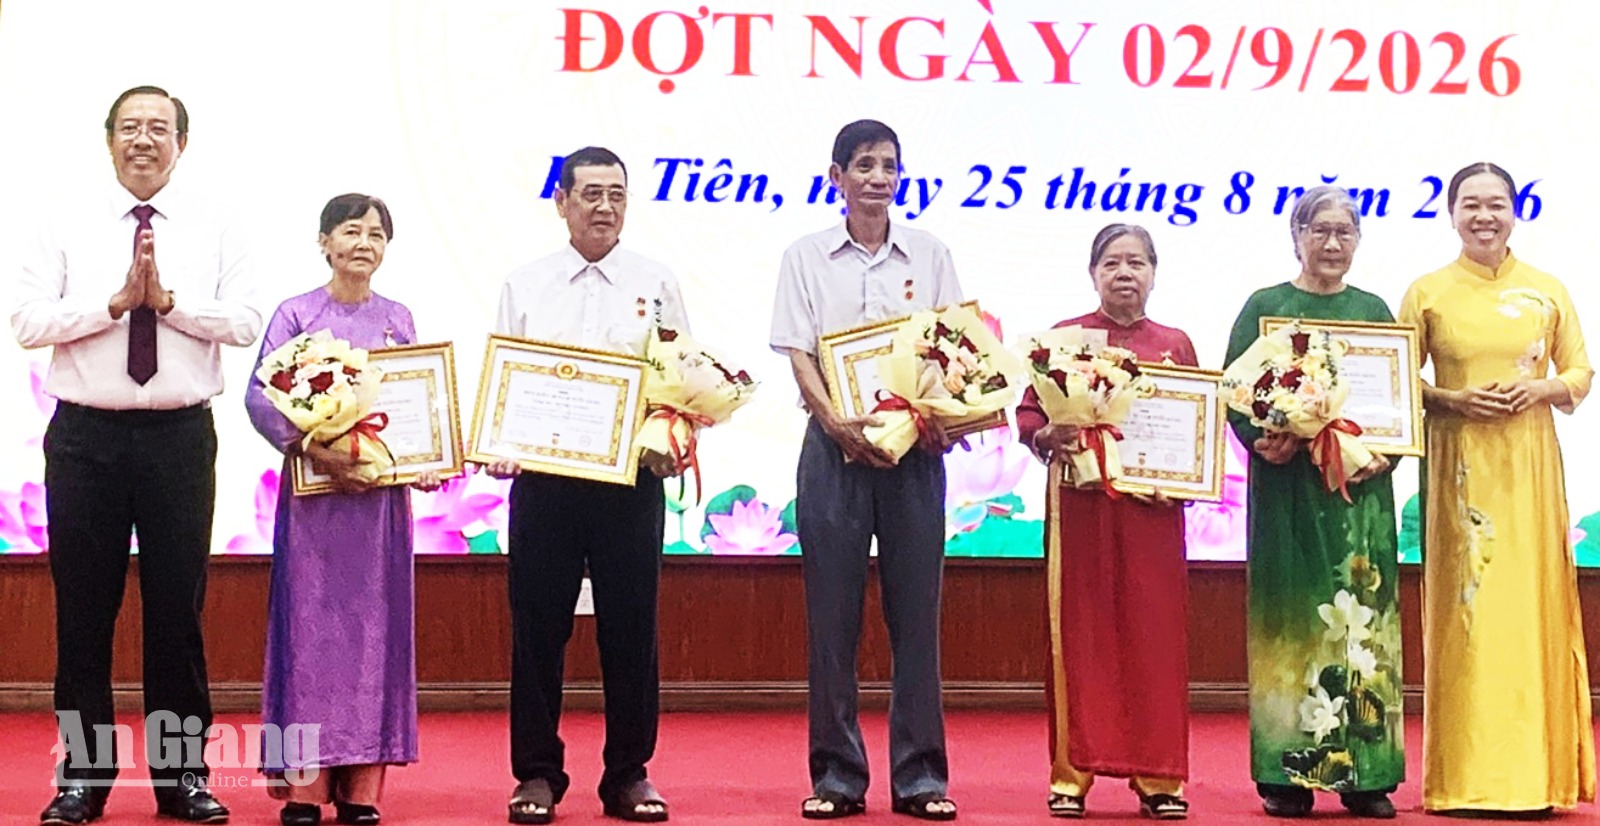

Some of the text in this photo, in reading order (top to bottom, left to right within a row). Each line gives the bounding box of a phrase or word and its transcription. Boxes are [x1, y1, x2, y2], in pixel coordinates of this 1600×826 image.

[555, 0, 1522, 97] ĐỢT NGÀY 02/9/2026
[652, 157, 784, 212] Tiên,
[960, 164, 1027, 210] 25
[1043, 166, 1205, 226] tháng
[1223, 170, 1256, 216] 8
[1411, 175, 1545, 222] 26
